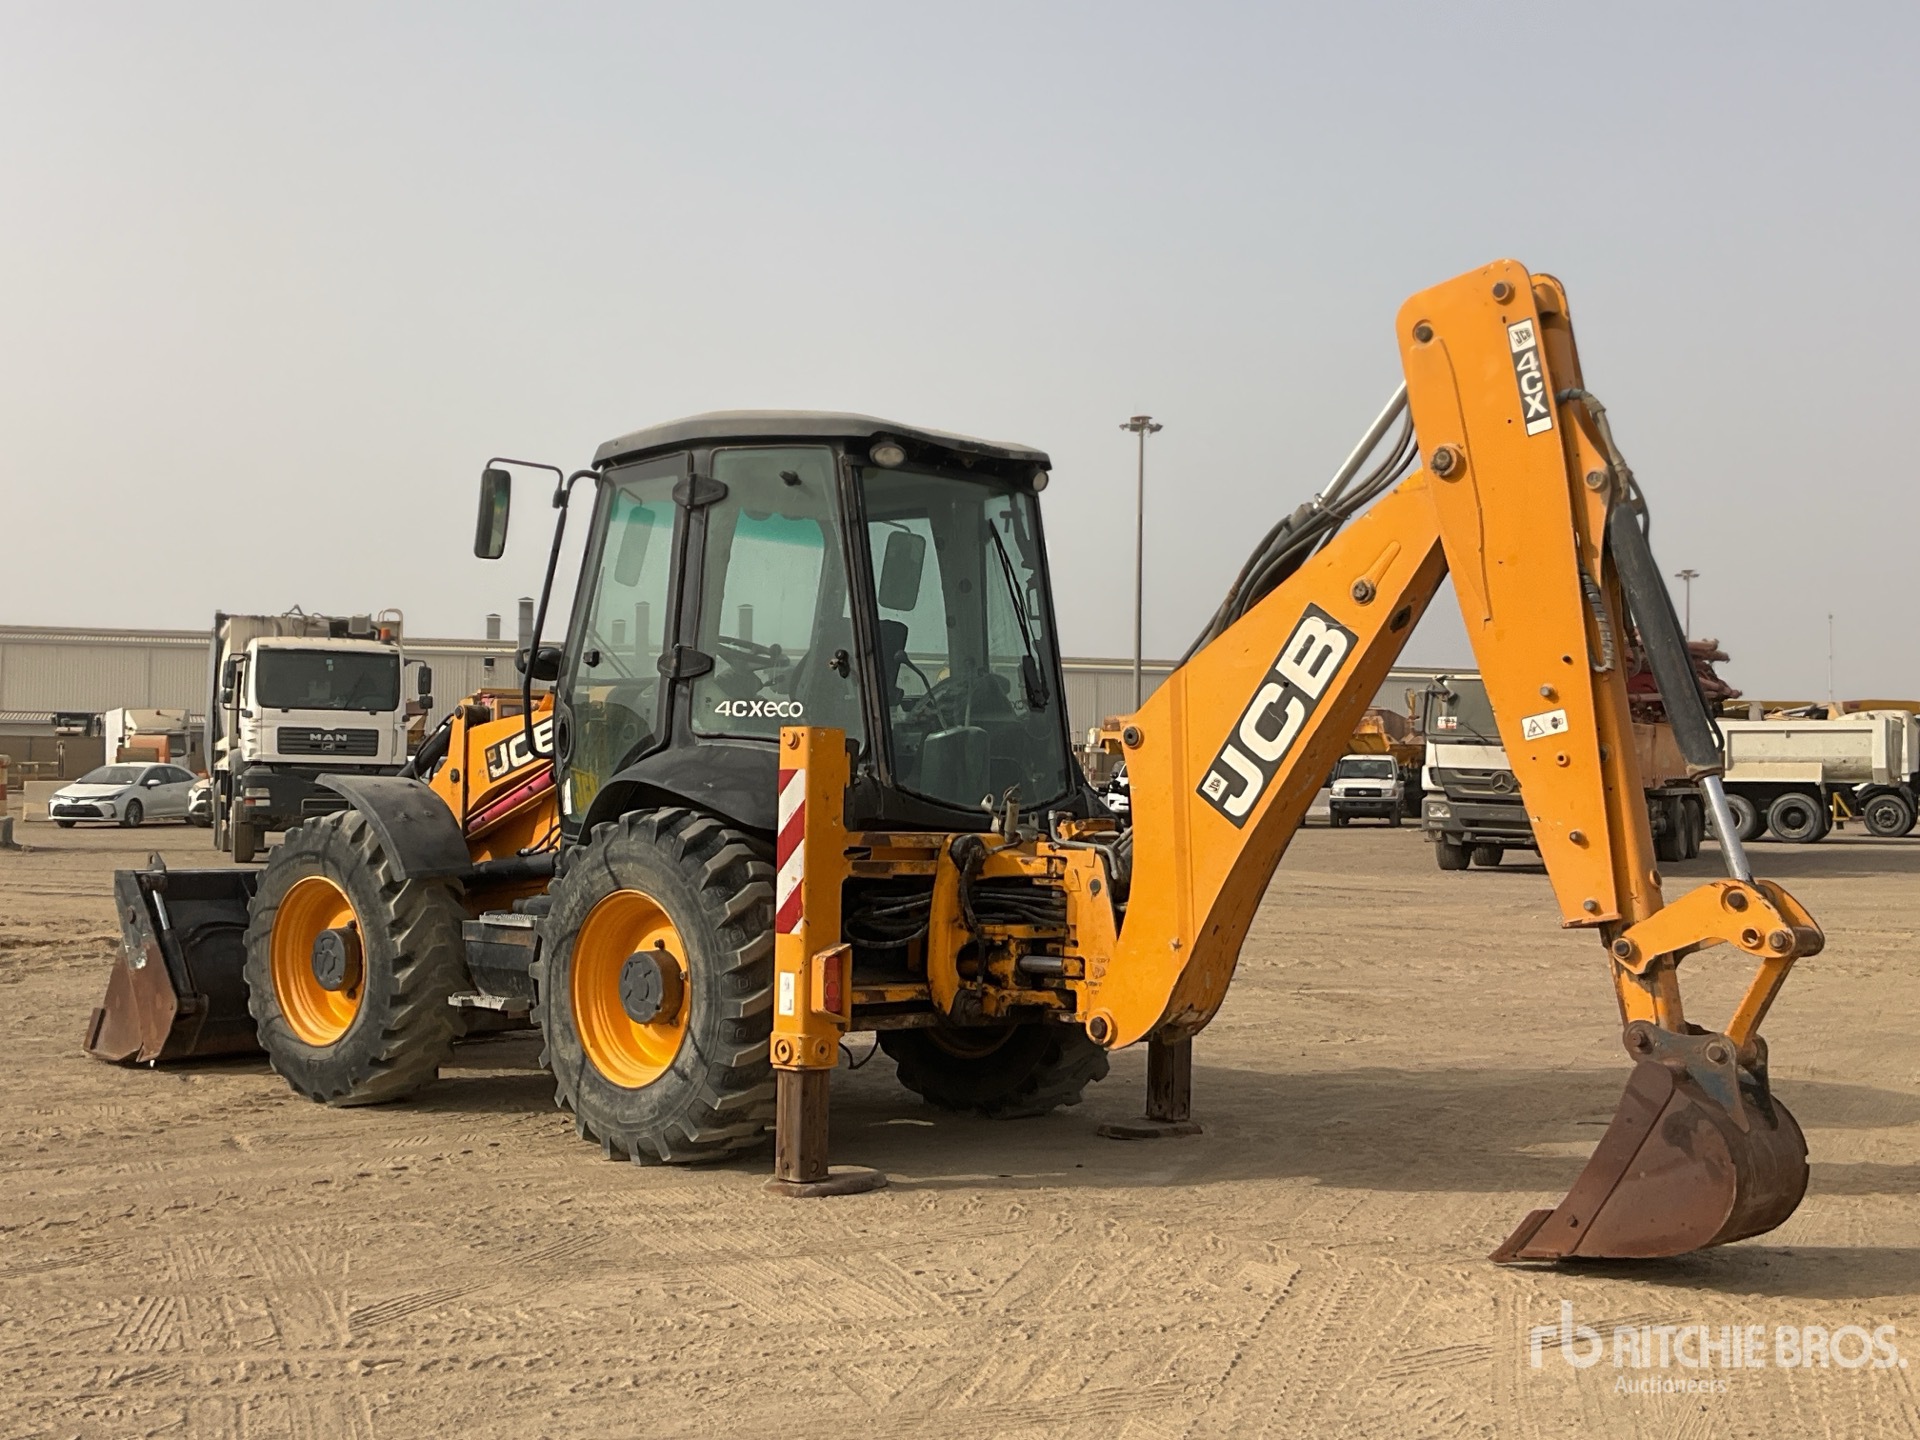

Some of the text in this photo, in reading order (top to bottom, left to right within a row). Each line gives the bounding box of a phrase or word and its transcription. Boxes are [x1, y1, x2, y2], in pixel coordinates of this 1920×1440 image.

[1514, 327, 1532, 344] JCB
[1516, 350, 1548, 418] 4CX
[714, 700, 804, 718] 4CXeco
[1220, 616, 1348, 817] JCB
[309, 733, 347, 742] MAN
